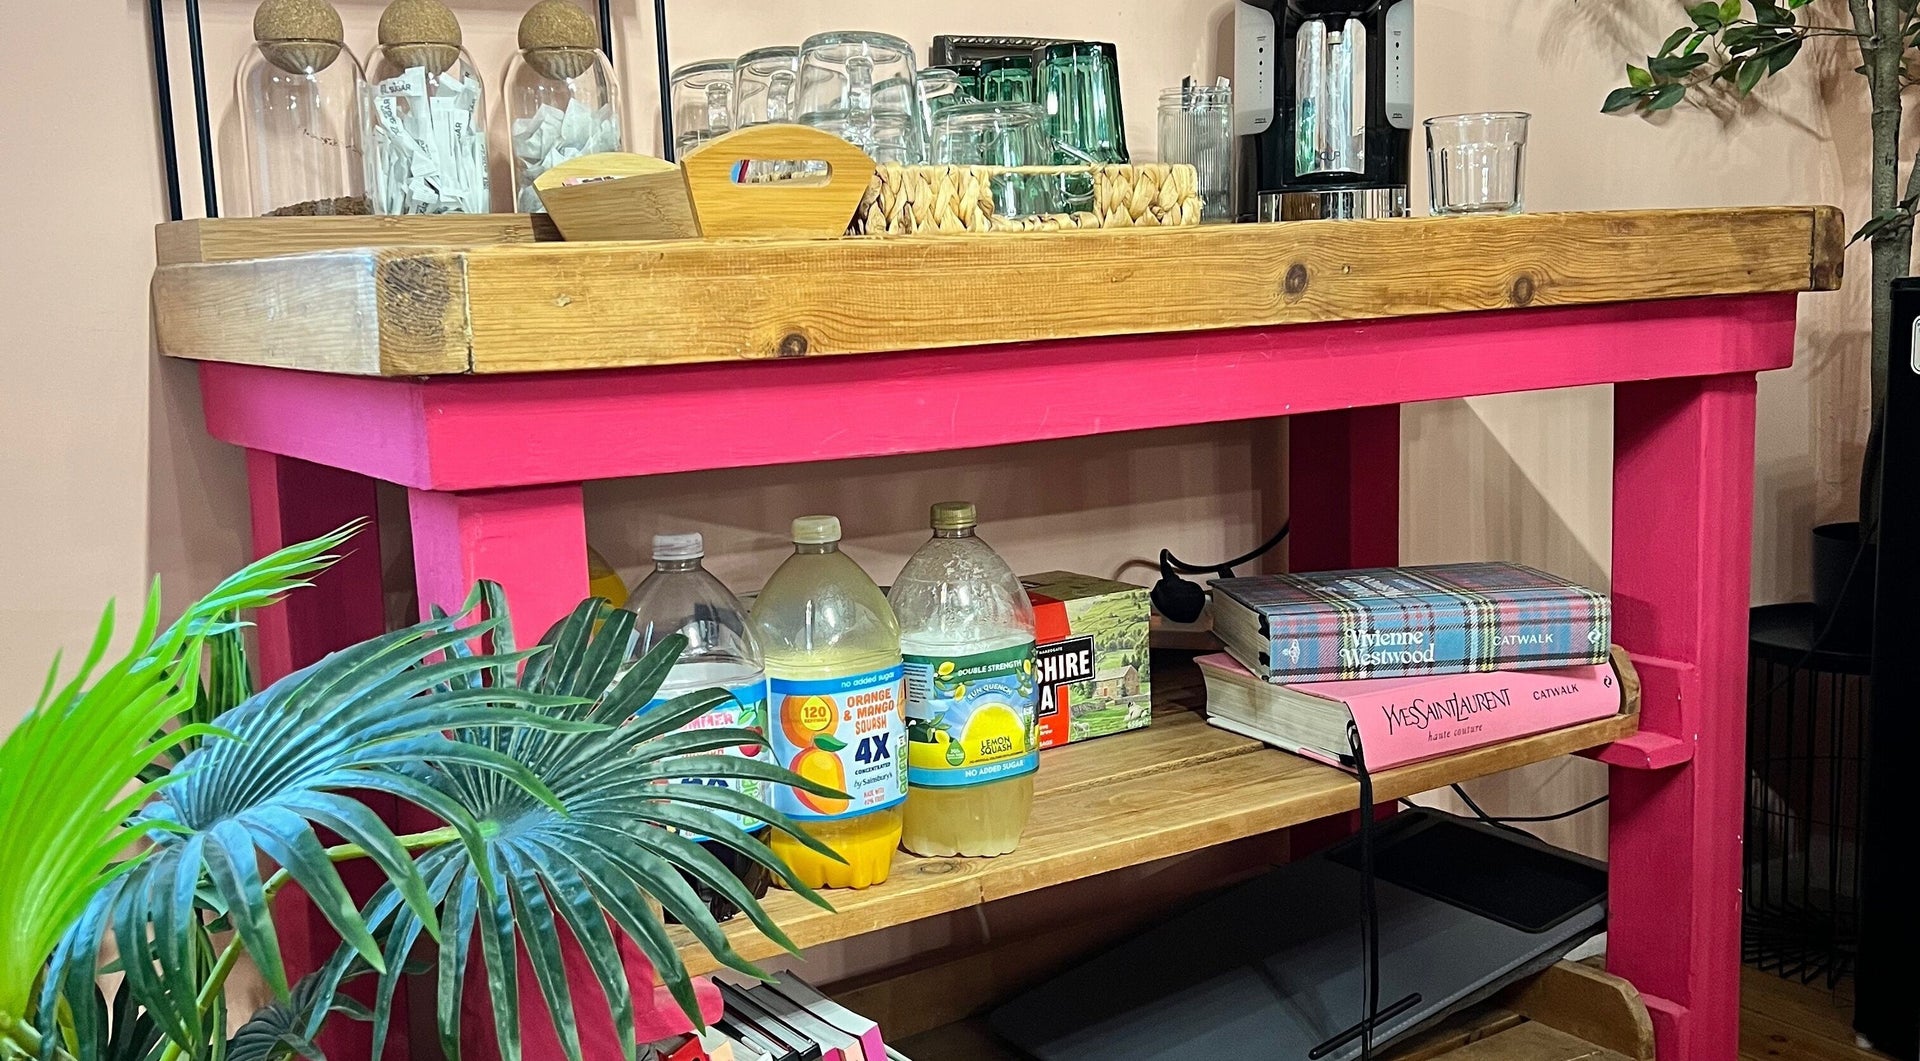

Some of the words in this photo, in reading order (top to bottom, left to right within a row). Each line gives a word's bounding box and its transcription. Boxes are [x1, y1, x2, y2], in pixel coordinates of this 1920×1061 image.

[389, 84, 411, 92] SUGAR
[1346, 628, 1424, 646] Vivienne
[1493, 633, 1555, 646] CATWALK
[1339, 642, 1435, 668] Westwood
[957, 666, 986, 677] DOUBLE
[988, 660, 1022, 672] STRENGTH
[1037, 649, 1091, 685] SHIRE
[841, 681, 851, 689] no
[853, 676, 877, 687] added
[878, 672, 895, 682] sugar
[847, 688, 892, 708] ORANGE
[984, 683, 1012, 696] QUENCH
[1533, 683, 1579, 701] CATWALK
[804, 706, 827, 718] 120
[843, 710, 853, 722] &
[857, 700, 895, 719] MANGO
[855, 716, 887, 735] SQUASH
[1427, 730, 1451, 742] haute
[1453, 725, 1482, 738] couture
[855, 732, 891, 765] 4X
[980, 736, 1011, 748] LEMON
[980, 743, 1012, 756] SQUASH
[855, 762, 891, 776] CONCENTRATED
[965, 769, 977, 778] NO
[979, 764, 1001, 775] ADDED
[1002, 760, 1024, 771] SUGAR
